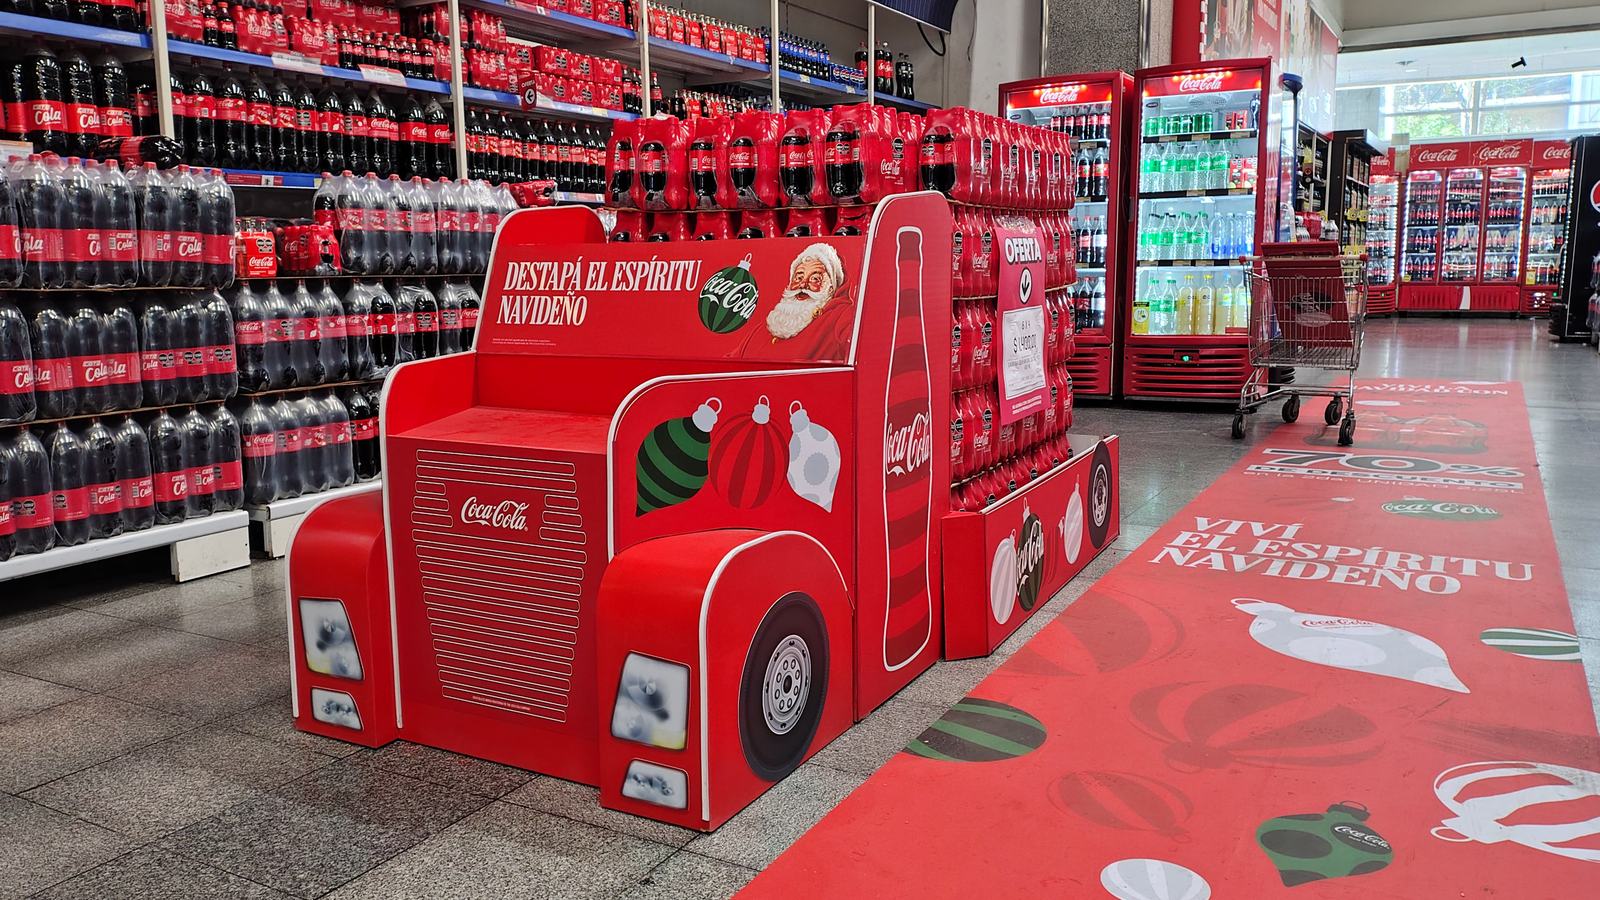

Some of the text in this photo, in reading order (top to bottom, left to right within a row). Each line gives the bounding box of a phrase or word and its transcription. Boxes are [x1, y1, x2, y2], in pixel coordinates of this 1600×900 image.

[1040, 86, 1080, 104] Coca-Cola
[1179, 74, 1224, 92] Coca-Cola
[1418, 149, 1459, 163] Coca-Cola
[1479, 145, 1522, 160] Coca-Cola
[1543, 147, 1571, 160] Coca-C
[1005, 238, 1042, 265] OFERTA
[503, 255, 702, 292] DESTAPÁ EL ESPÍRITU
[497, 291, 588, 326] NAVIDEÑO
[700, 272, 759, 320] Coca-Cola
[1262, 448, 1525, 477] 70%
[1306, 470, 1517, 488] DESCUENTO
[461, 496, 529, 531] Coca-Cola
[1381, 502, 1498, 515] Coca-Cola
[1194, 516, 1305, 540] VIVÍ
[1017, 519, 1044, 596] oca-Cola
[1166, 530, 1536, 581] EL ESPÍRITU
[1334, 825, 1390, 850] Coca-Cola
